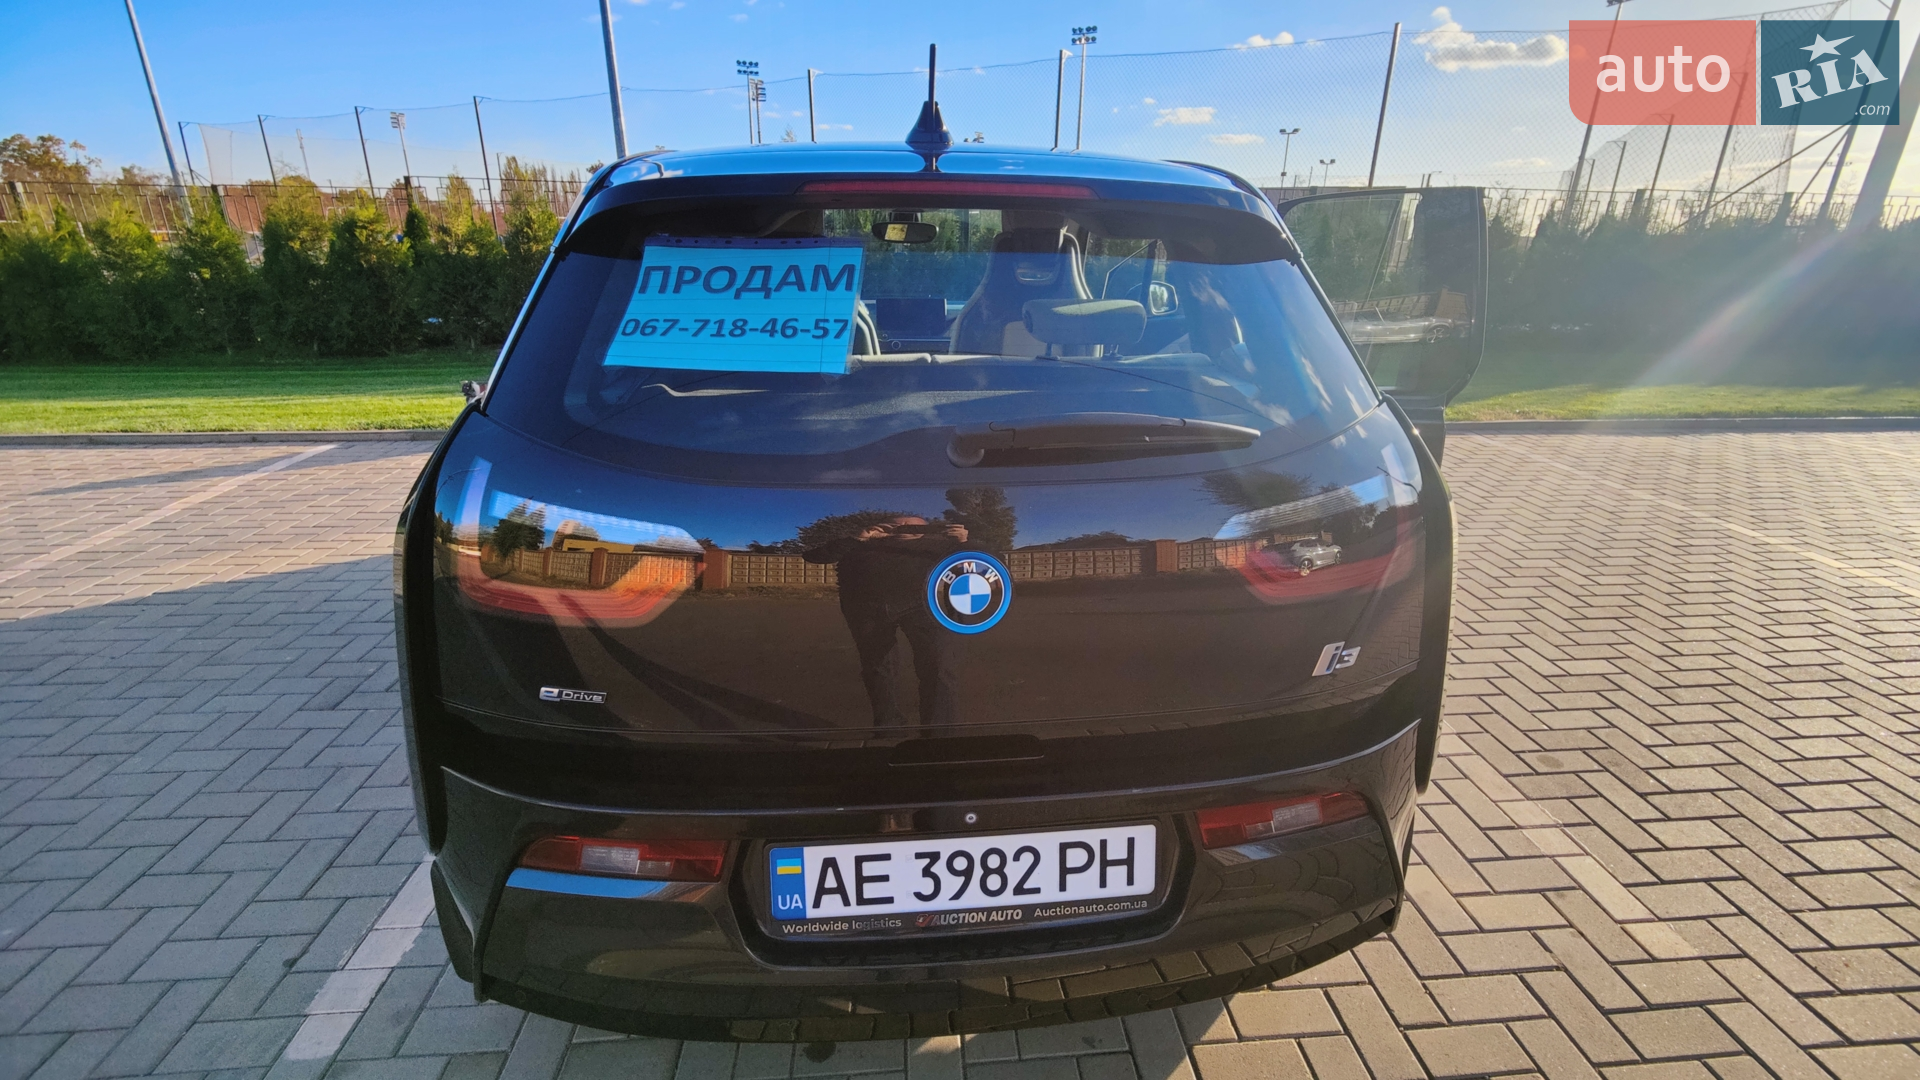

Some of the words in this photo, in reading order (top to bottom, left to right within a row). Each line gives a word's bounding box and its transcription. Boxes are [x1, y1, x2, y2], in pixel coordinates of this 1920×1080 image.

[638, 263, 856, 299] ПРОДАМ
[621, 317, 849, 339] 067-718-46-57
[941, 561, 999, 585] BMW
[1311, 641, 1361, 677] i3
[812, 852, 895, 909] AE
[913, 845, 1042, 902] 3982
[1058, 836, 1136, 893] PH
[777, 893, 804, 911] UA
[1034, 899, 1148, 918] Auctionauto.com.ua
[989, 908, 1022, 922] AUTO
[782, 920, 850, 934] Worldwide
